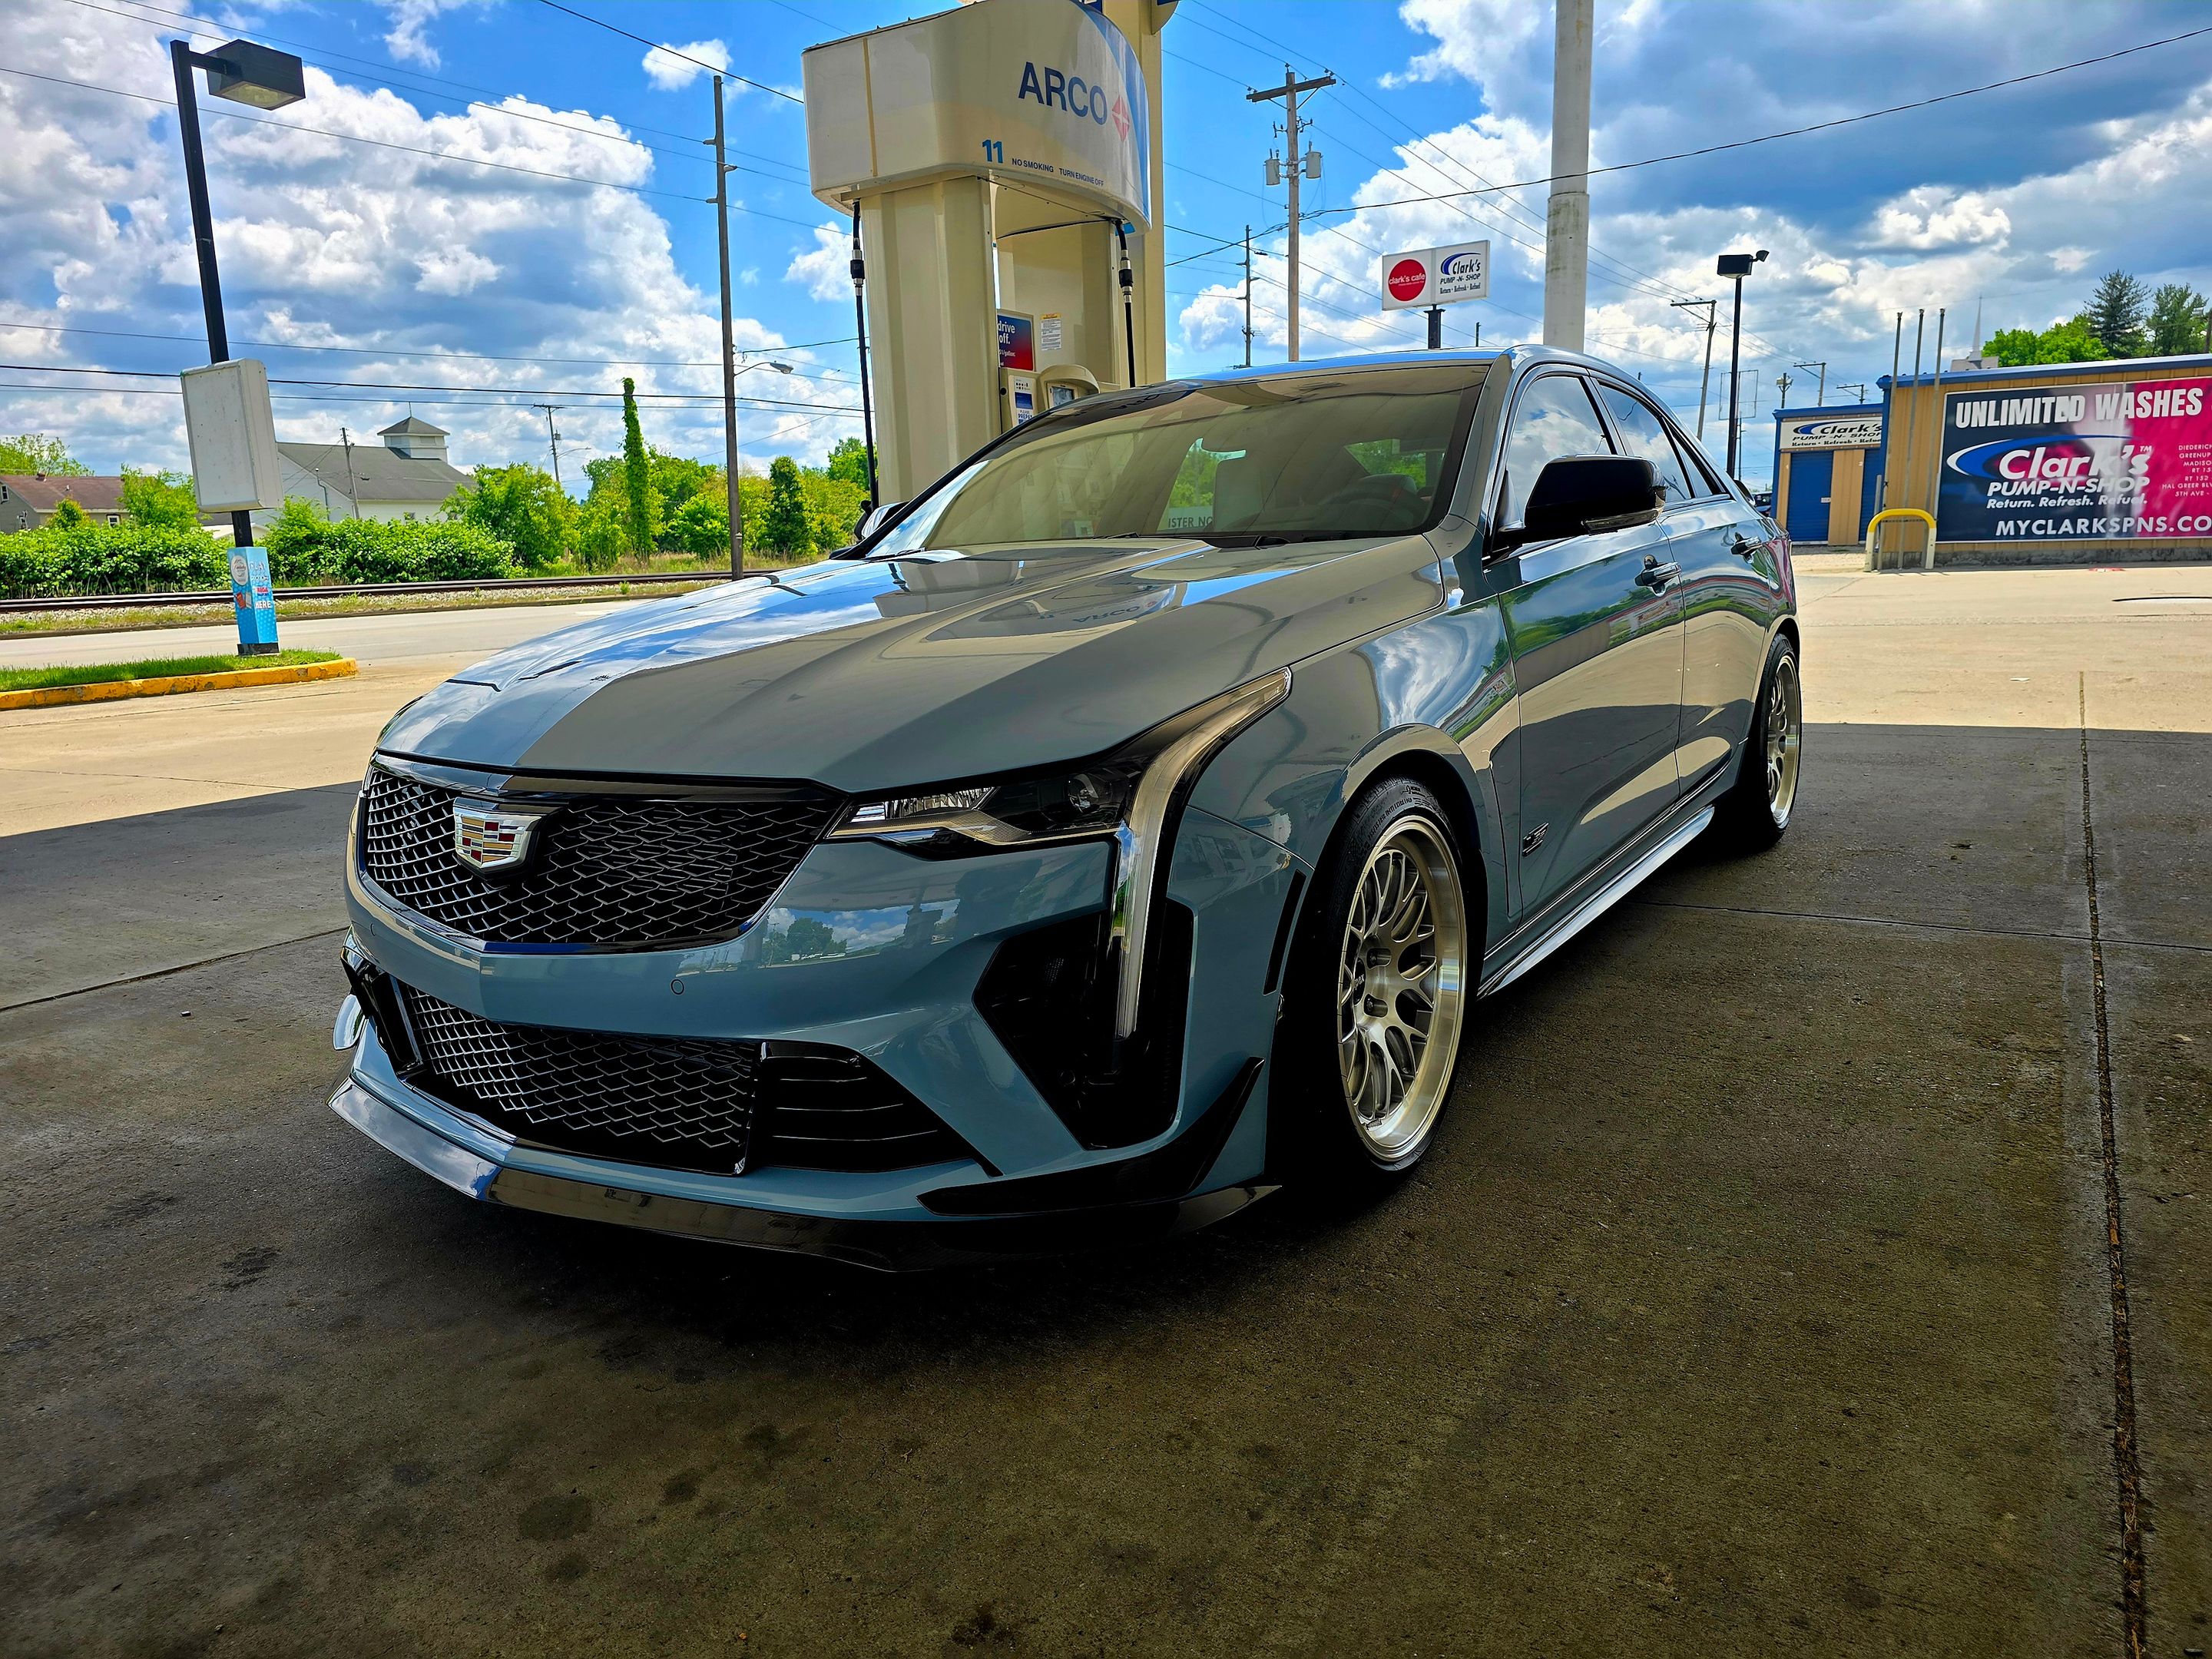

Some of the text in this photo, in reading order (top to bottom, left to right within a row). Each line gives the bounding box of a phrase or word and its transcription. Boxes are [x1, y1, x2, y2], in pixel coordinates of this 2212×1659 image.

[1018, 61, 1108, 125] ARCO
[982, 139, 1004, 164] 11
[1023, 160, 1054, 172] SMOKING
[1059, 167, 1075, 178] TURN
[1075, 172, 1094, 184] ENGINE
[1094, 178, 1104, 187] OFF
[1452, 259, 1481, 274] Clark's
[1389, 275, 1410, 285] clark's
[1411, 273, 1426, 281] cafe
[1465, 273, 1481, 281] SHOP
[998, 320, 1015, 333] drive
[998, 333, 1011, 344] off.
[1955, 388, 2204, 429] UNLIMITED WASHES
[1820, 423, 1882, 435] Clark's
[1998, 445, 2151, 480] Clark's
[1986, 476, 2151, 497] PUMP-N-SHOP
[1986, 492, 2147, 509] Return. Refresh. Refuel.
[1168, 516, 1194, 528] ISTER
[255, 600, 272, 609] HERE
